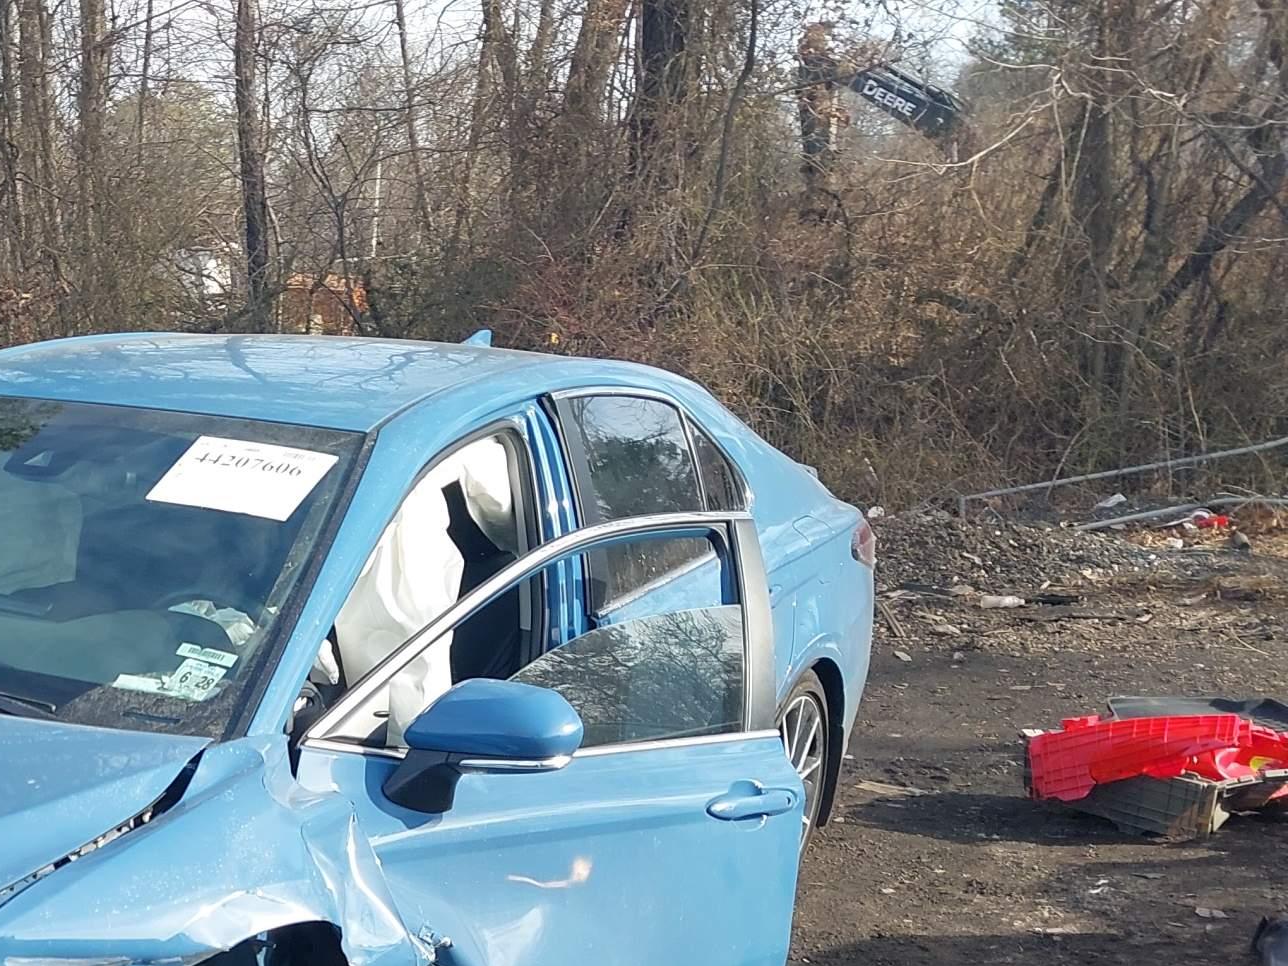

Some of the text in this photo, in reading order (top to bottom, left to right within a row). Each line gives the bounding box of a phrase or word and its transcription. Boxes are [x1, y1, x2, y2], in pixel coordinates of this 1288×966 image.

[863, 79, 917, 116] DEERE
[195, 452, 302, 477] 44207606
[179, 671, 215, 690] 6 28
